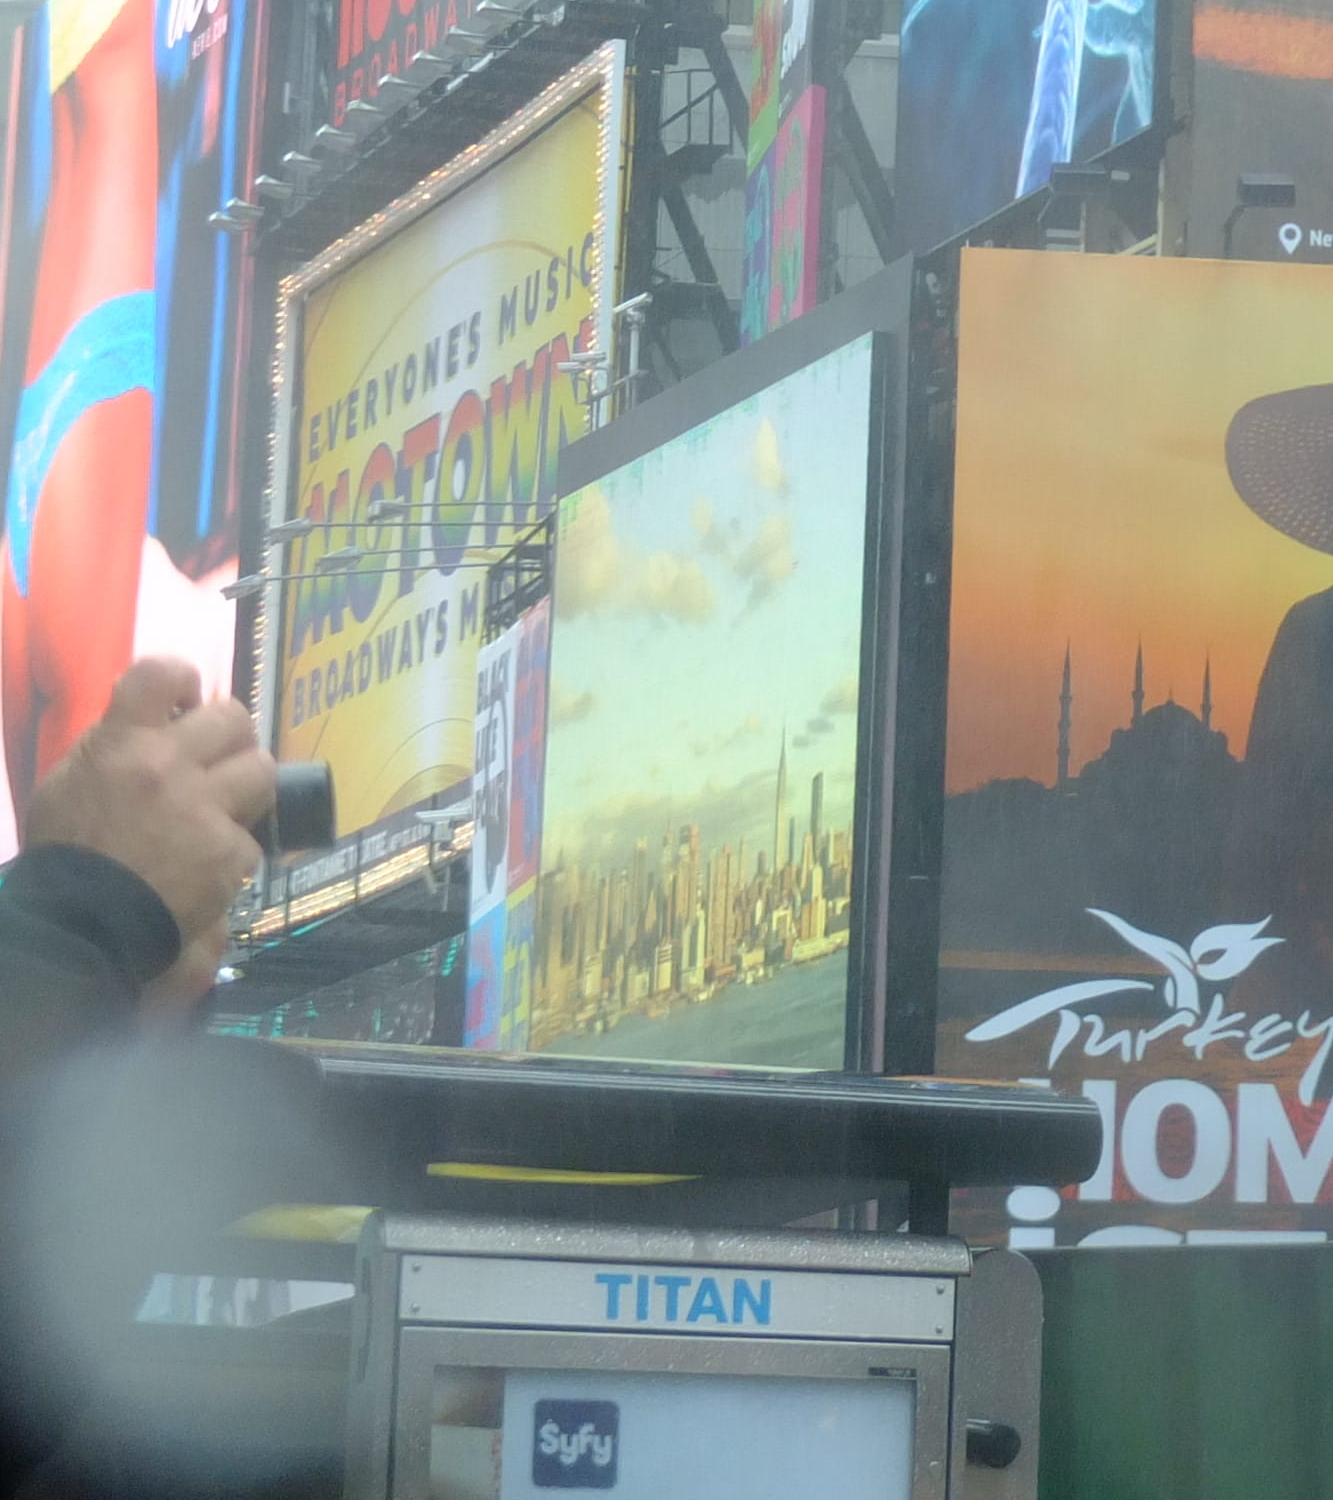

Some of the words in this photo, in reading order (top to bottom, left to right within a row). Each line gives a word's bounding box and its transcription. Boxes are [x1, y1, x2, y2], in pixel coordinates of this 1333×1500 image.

[307, 311, 484, 465] EVERYONE'S
[498, 231, 594, 346] MUSIC
[289, 315, 592, 660] MOTOWN
[293, 599, 449, 729] BROADWAY'S
[594, 1272, 773, 1326] TITAN
[538, 1418, 614, 1467] Syfy
